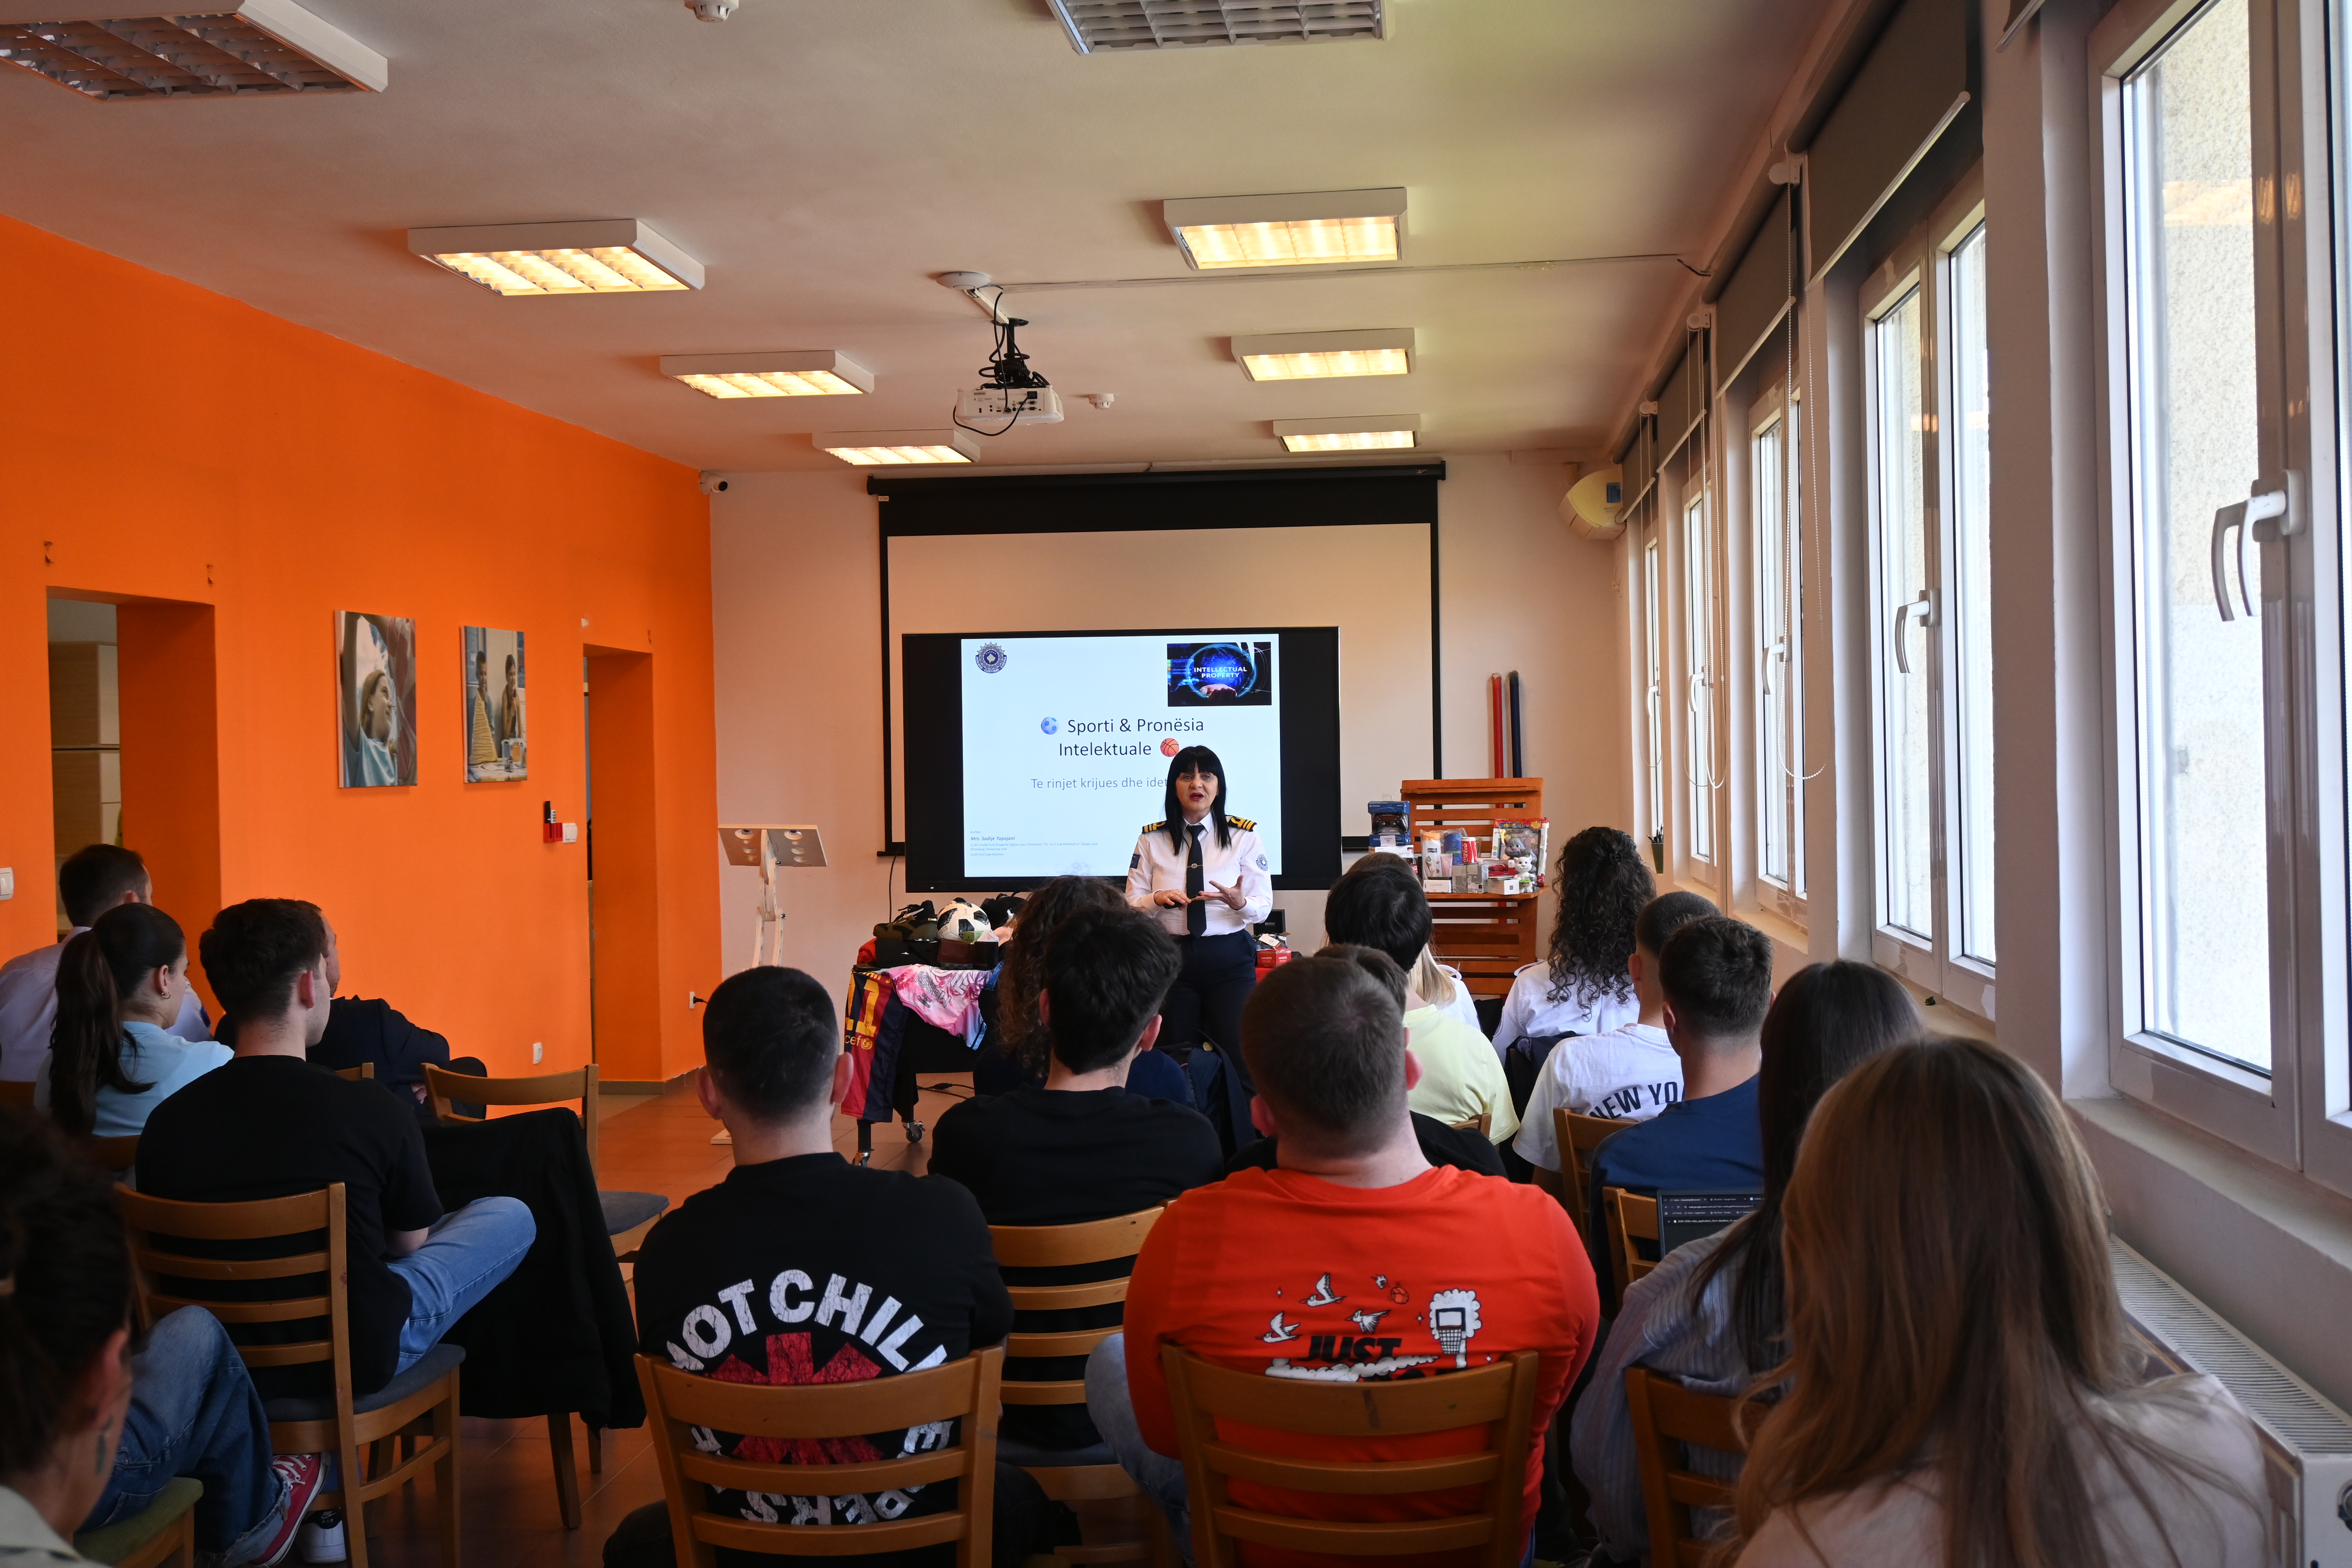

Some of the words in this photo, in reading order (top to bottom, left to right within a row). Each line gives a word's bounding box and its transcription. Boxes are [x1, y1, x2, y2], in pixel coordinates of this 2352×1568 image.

[1068, 719, 1113, 736] Sporti
[1119, 718, 1132, 732] &
[1138, 718, 1204, 732] Pronësia
[1059, 741, 1152, 756] Intelektuale
[1031, 779, 1043, 788] Te
[1047, 778, 1077, 790] rinjet
[1081, 777, 1118, 790] krijues
[1122, 777, 1143, 787] dhe
[914, 971, 952, 1008] MESSI
[1589, 1087, 1641, 1119] NEW
[1648, 1081, 1685, 1105] YO
[1297, 1335, 1402, 1363] JUST
